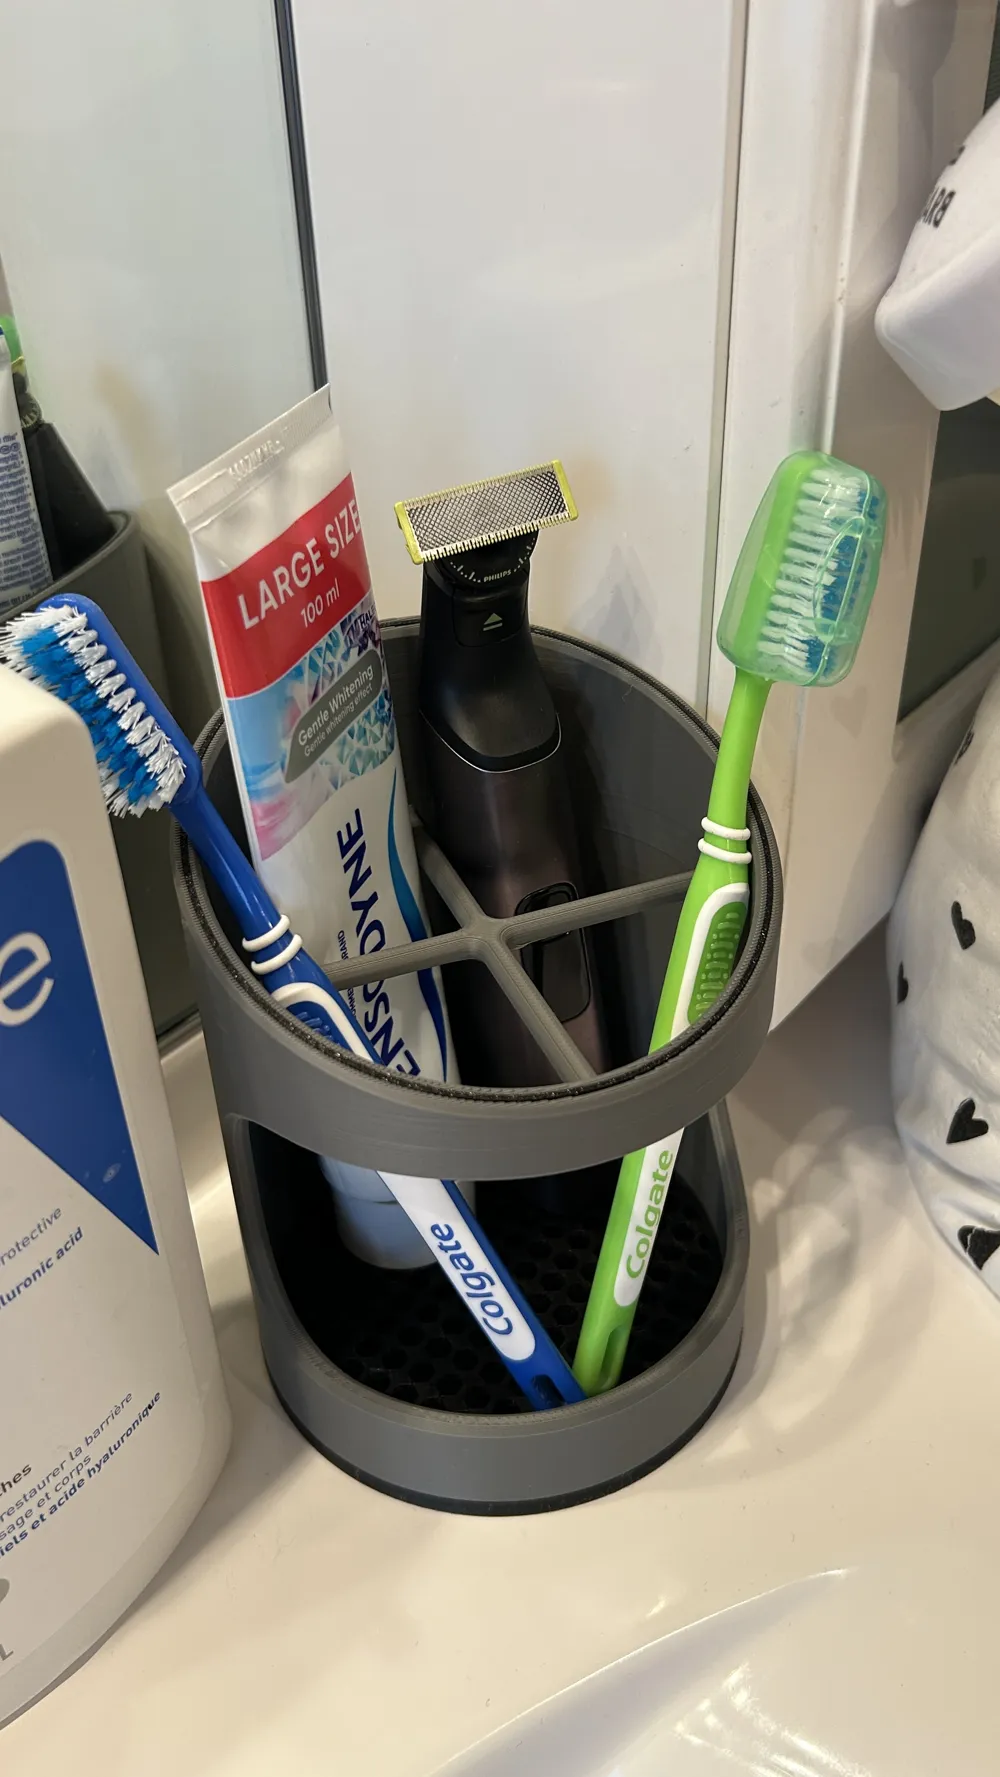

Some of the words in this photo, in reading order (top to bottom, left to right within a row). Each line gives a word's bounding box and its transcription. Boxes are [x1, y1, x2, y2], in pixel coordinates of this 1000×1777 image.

[238, 537, 325, 630] LARGE
[325, 499, 361, 559] SIZE
[300, 594, 324, 628] 100
[325, 577, 340, 607] ml
[483, 569, 512, 583] PHILIPS
[298, 710, 329, 745] Gentle
[329, 665, 374, 713] Whitening
[304, 732, 326, 757] Gentle
[326, 702, 354, 735] whitening
[354, 683, 373, 705] effect
[0, 1207, 62, 1266] rotective
[626, 1150, 673, 1279] Colgate
[0, 1257, 54, 1308] luronic
[55, 1226, 84, 1260] acid
[430, 1223, 513, 1335] Colgate
[0, 1460, 66, 1523] restaurer
[68, 1446, 83, 1461] la
[84, 1393, 133, 1446] barrière
[0, 1529, 28, 1558] iels
[31, 1513, 47, 1530] et
[48, 1478, 86, 1515] acide
[86, 1391, 160, 1479] hyaluronique
[37, 1492, 52, 1508] et
[54, 1455, 92, 1493] corps
